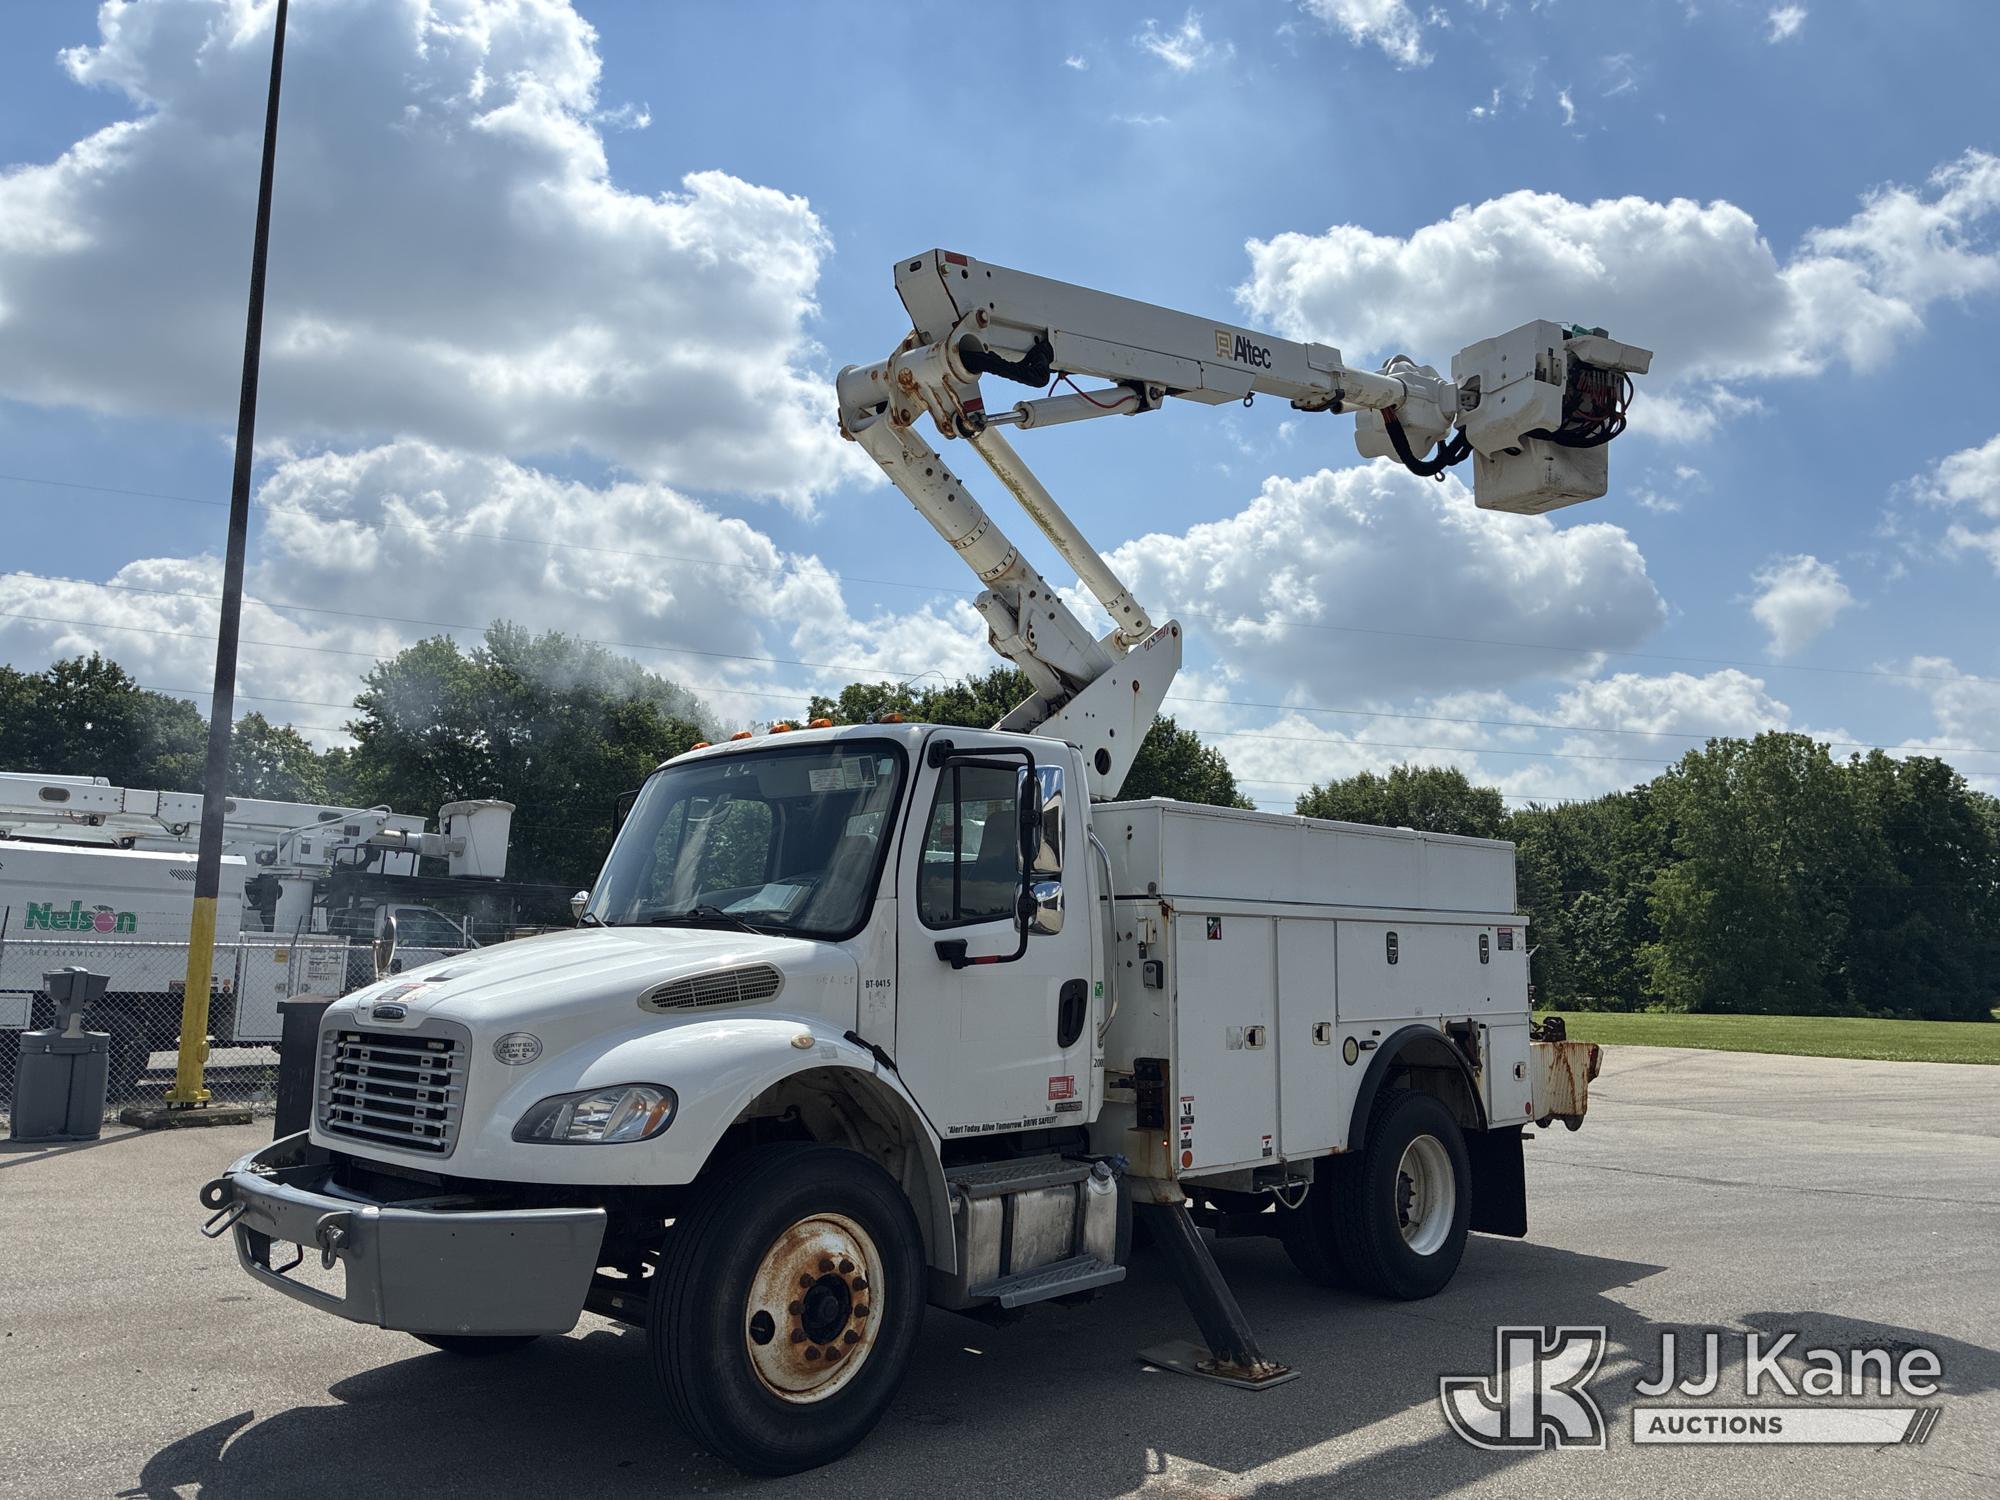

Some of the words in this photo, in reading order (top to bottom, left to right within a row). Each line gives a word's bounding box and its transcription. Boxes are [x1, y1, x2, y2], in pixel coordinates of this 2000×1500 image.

[1234, 335, 1271, 369] Altec
[24, 900, 138, 934] Nelson
[865, 979, 891, 989] BT-0415
[982, 1123, 996, 1132] Alive
[1023, 1118, 1039, 1128] DRIVE
